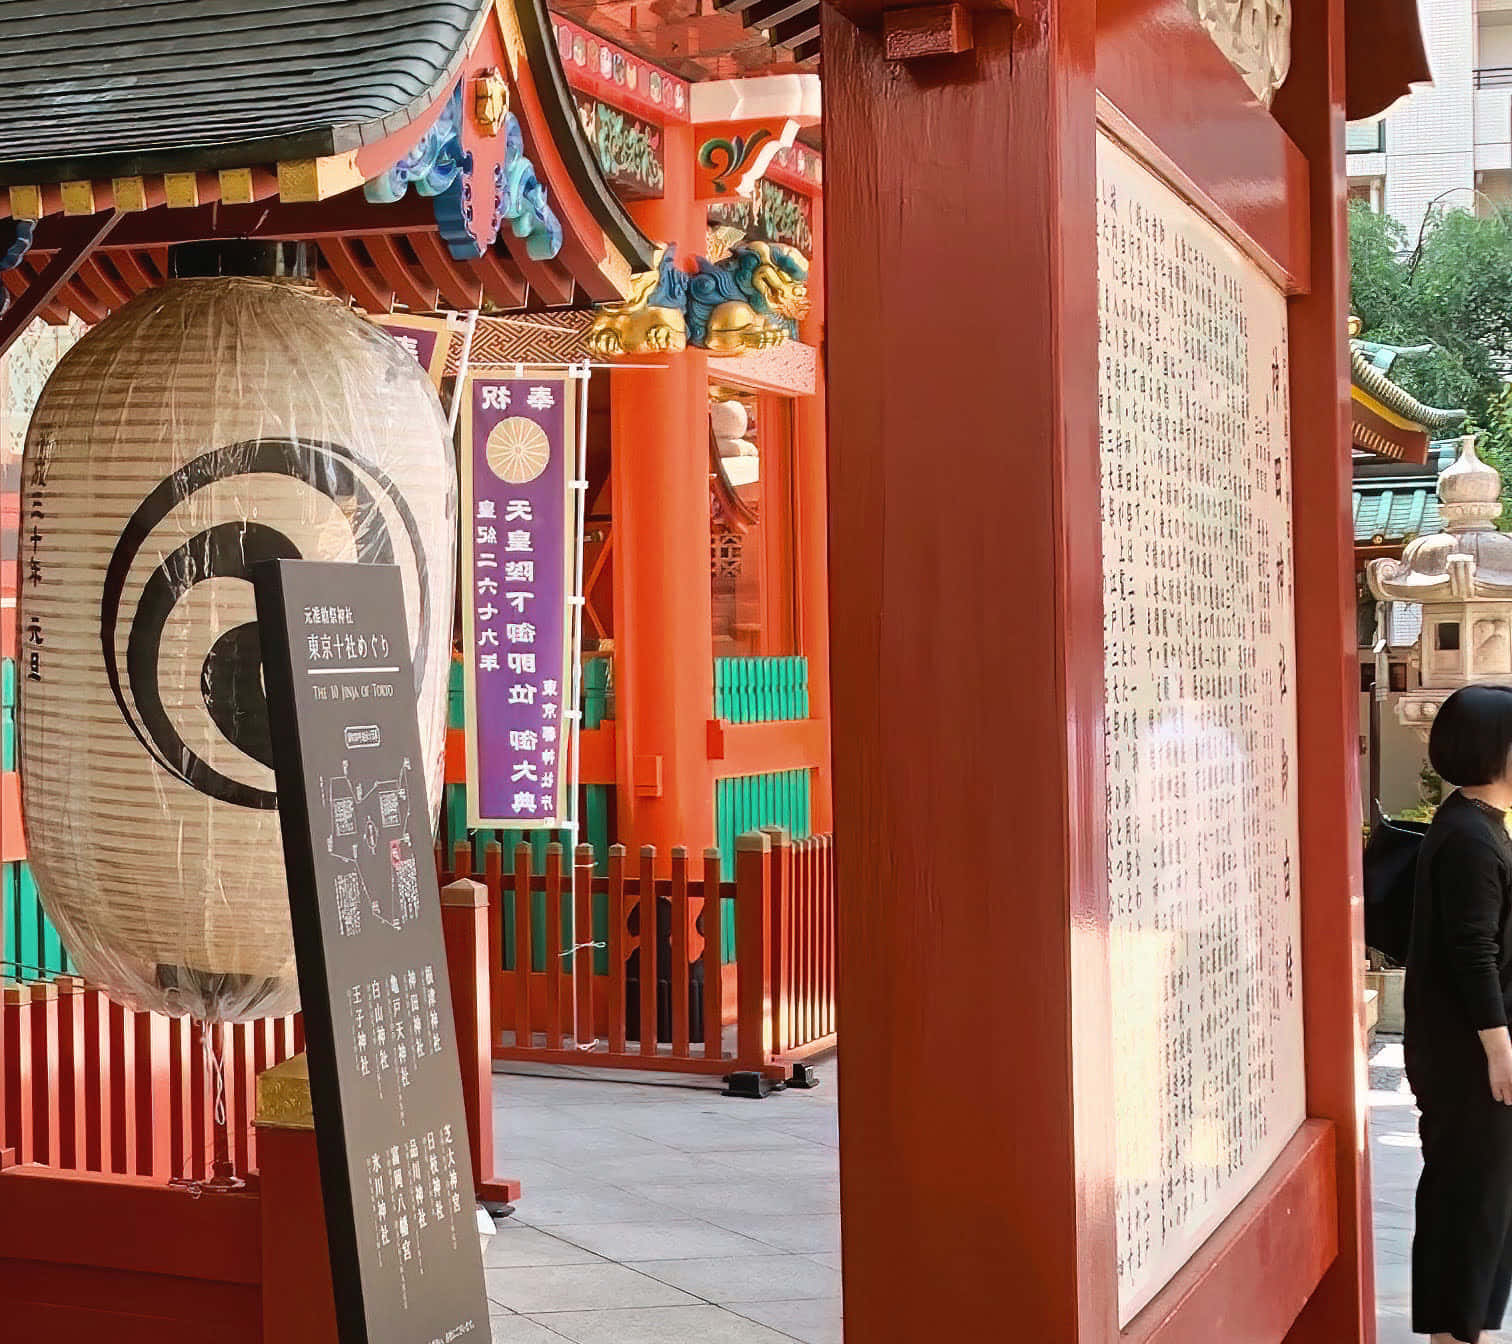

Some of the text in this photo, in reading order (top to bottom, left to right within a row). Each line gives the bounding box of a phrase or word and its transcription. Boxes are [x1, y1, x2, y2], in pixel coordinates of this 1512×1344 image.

[28, 617, 44, 681] 元旦
[307, 633, 389, 661] 東京十社めぐり
[330, 684, 339, 700] 10
[352, 984, 370, 1076] 王子神社
[372, 979, 389, 1070] 白山神社
[371, 1152, 390, 1246] 氷川神社
[409, 1138, 428, 1229] 品川神社
[427, 1131, 445, 1221] 日枝神社
